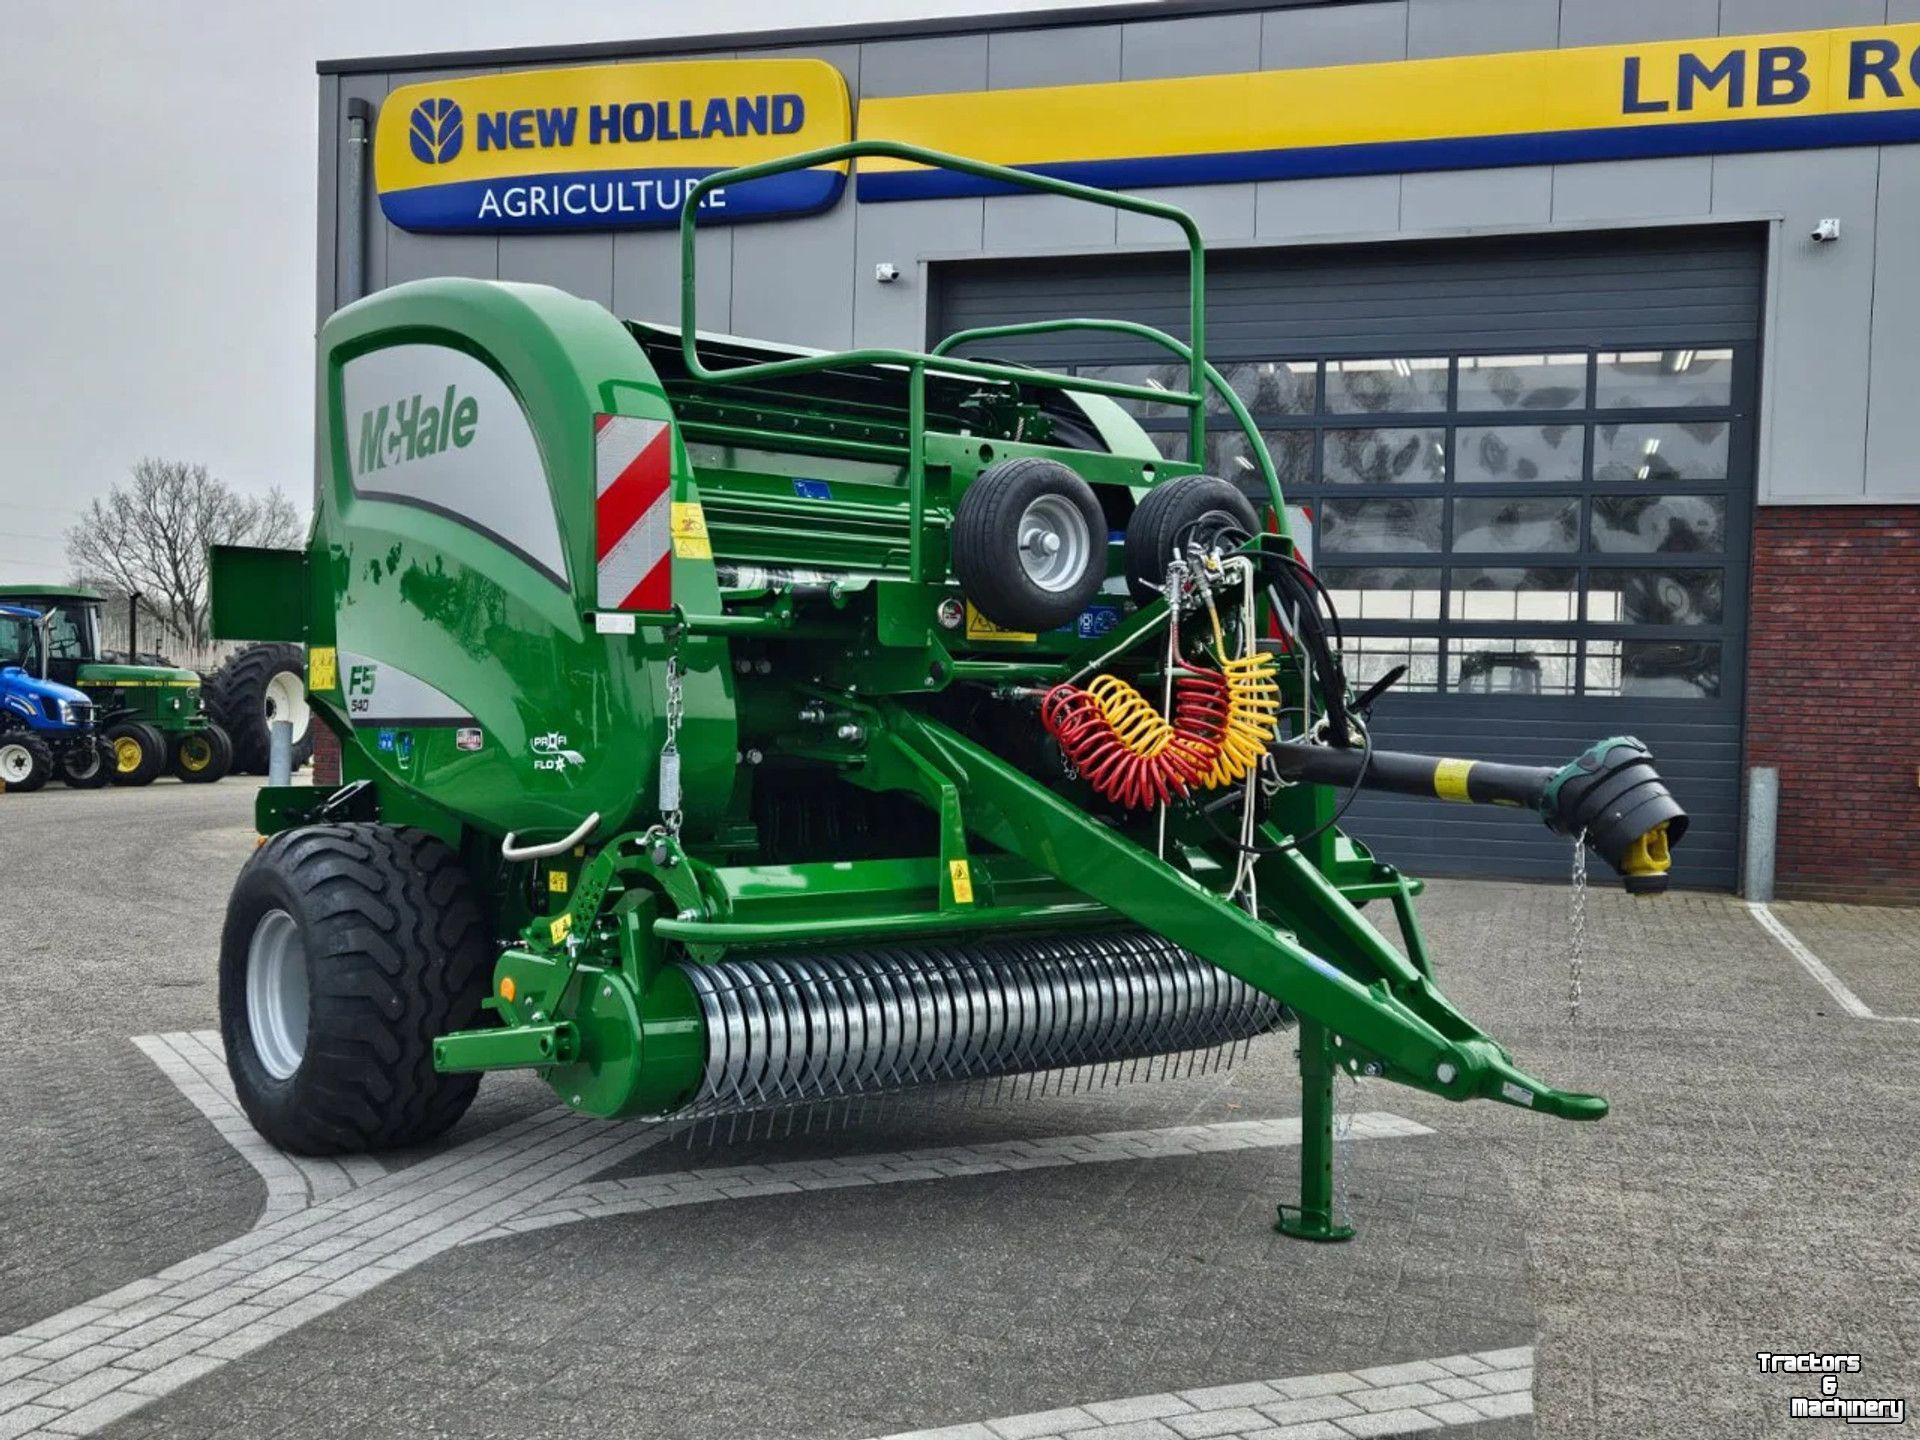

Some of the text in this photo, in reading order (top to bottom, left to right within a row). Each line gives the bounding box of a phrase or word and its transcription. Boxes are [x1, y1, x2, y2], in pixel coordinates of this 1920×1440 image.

[1622, 46, 1811, 114] LMB
[476, 94, 805, 151] NEW HOLLAND
[349, 664, 377, 696] F5
[351, 699, 369, 712] 540
